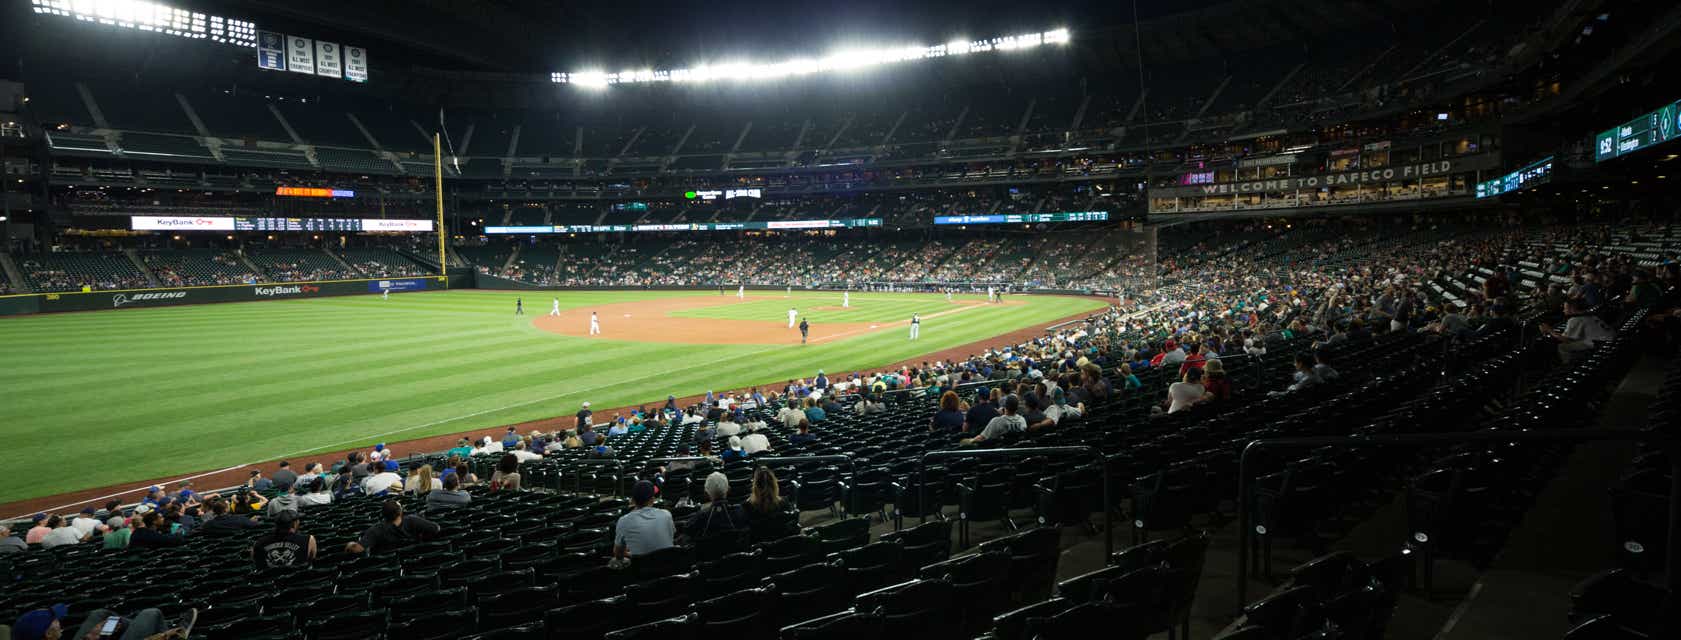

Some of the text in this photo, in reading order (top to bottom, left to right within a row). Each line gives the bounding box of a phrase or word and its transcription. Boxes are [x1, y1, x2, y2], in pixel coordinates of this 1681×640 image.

[1202, 160, 1451, 194] WELCOME TO SAFECO FIELD
[157, 218, 194, 226] KeyBank
[255, 285, 301, 296] KeyBank
[132, 291, 186, 301] BOEING
